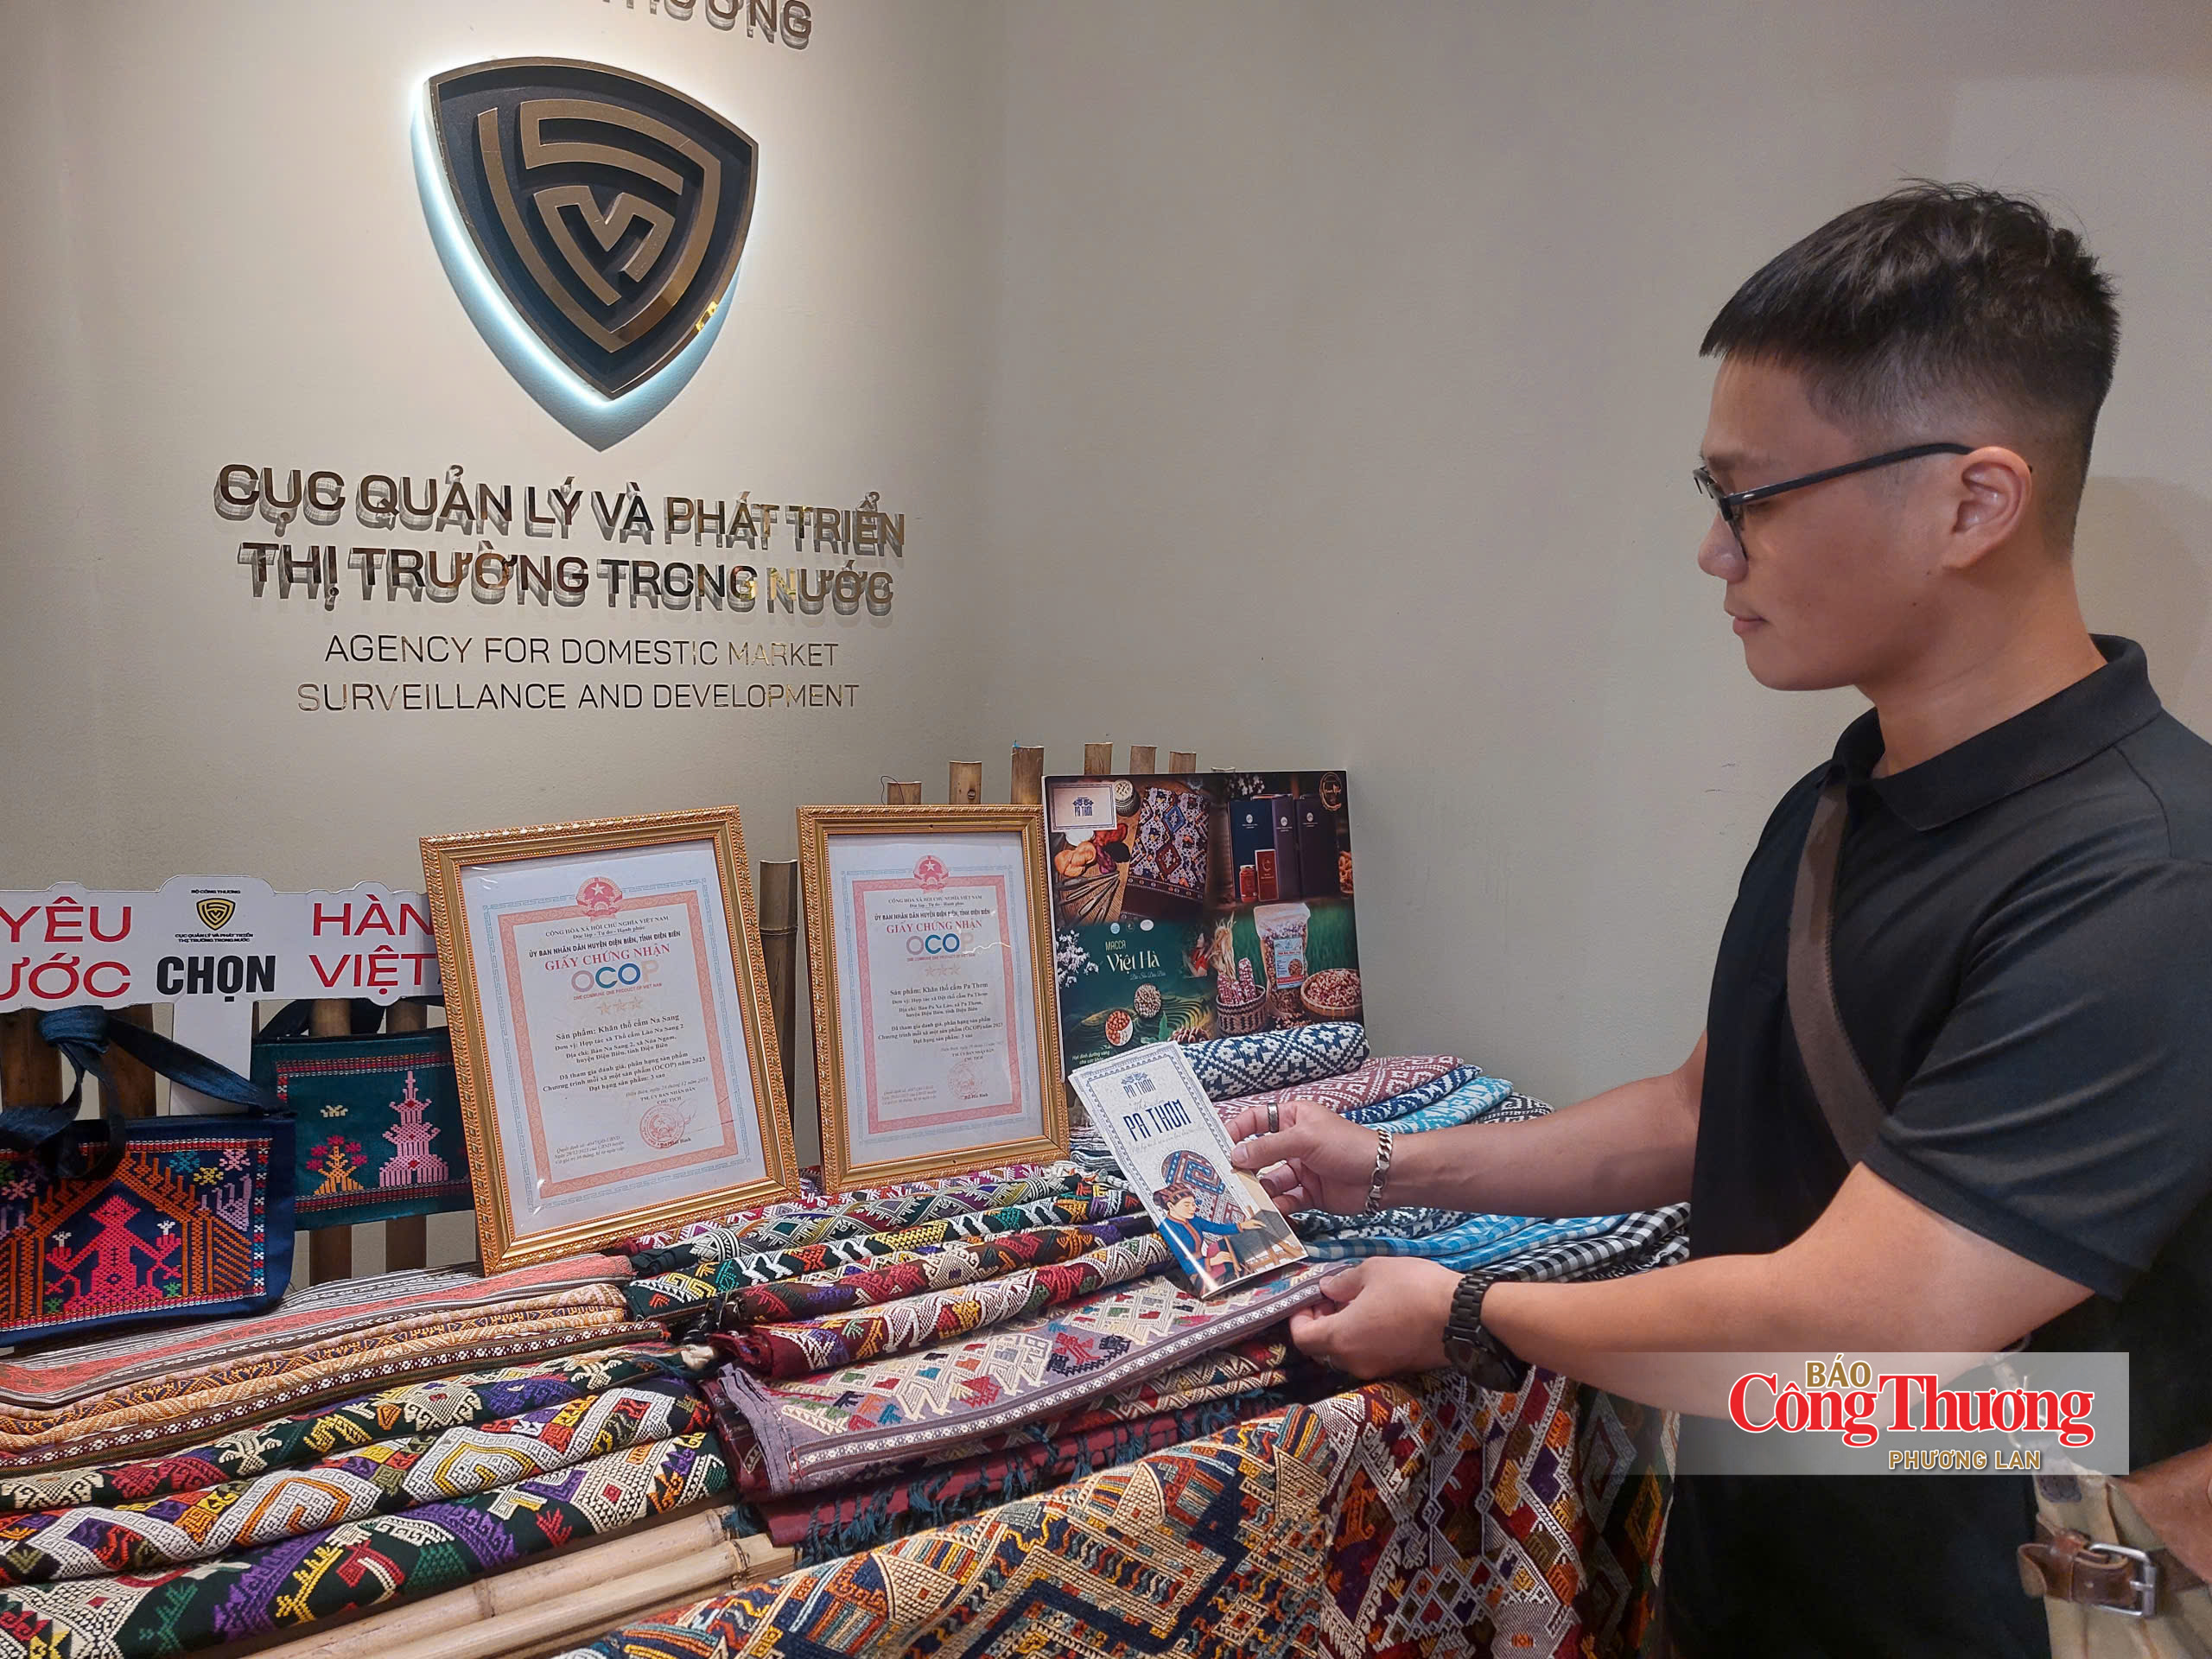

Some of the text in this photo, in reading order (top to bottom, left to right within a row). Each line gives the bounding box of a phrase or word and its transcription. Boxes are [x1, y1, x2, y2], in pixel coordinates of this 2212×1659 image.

[218, 463, 905, 550] CỤC QUẢN LÝ VÀ PHÁT TRIỂN
[241, 540, 893, 607] THỊ TRƯỜNG TRONG NƯỚC
[324, 633, 839, 667] AGENCY FOR DOMESTIC MARKET
[296, 683, 860, 711] SURVEILLANCE AND DEVELOPMENT
[0, 895, 132, 943] YÊU
[886, 918, 982, 934] GIẤY CHỨNG NHẬN
[529, 949, 537, 958] ỦY
[538, 949, 552, 957] BAN
[553, 945, 572, 954] NHÂN
[572, 943, 587, 951] DÂN
[588, 940, 607, 950] HUYỆN
[608, 937, 622, 947] ĐIỆN
[639, 932, 653, 943] TỈNH
[668, 929, 681, 938] BIÊN
[544, 943, 671, 971] GIẤY CHỨNG NHẬN
[906, 932, 976, 956] OCOP
[1105, 939, 1127, 951] MACCA
[308, 944, 437, 995] VIỆT
[570, 959, 660, 993] OCOP
[1106, 950, 1160, 975] Việt Hà
[156, 954, 276, 1002] CHỌN
[556, 1033, 570, 1041] Sản
[572, 1027, 597, 1039] phẩm:
[598, 1024, 619, 1033] Khăn
[620, 1020, 632, 1030] thổ
[633, 1018, 649, 1027] cẩm
[1122, 1084, 1137, 1099] PA
[1122, 1112, 1152, 1142] PA
[1145, 1098, 1192, 1134] THƠM
